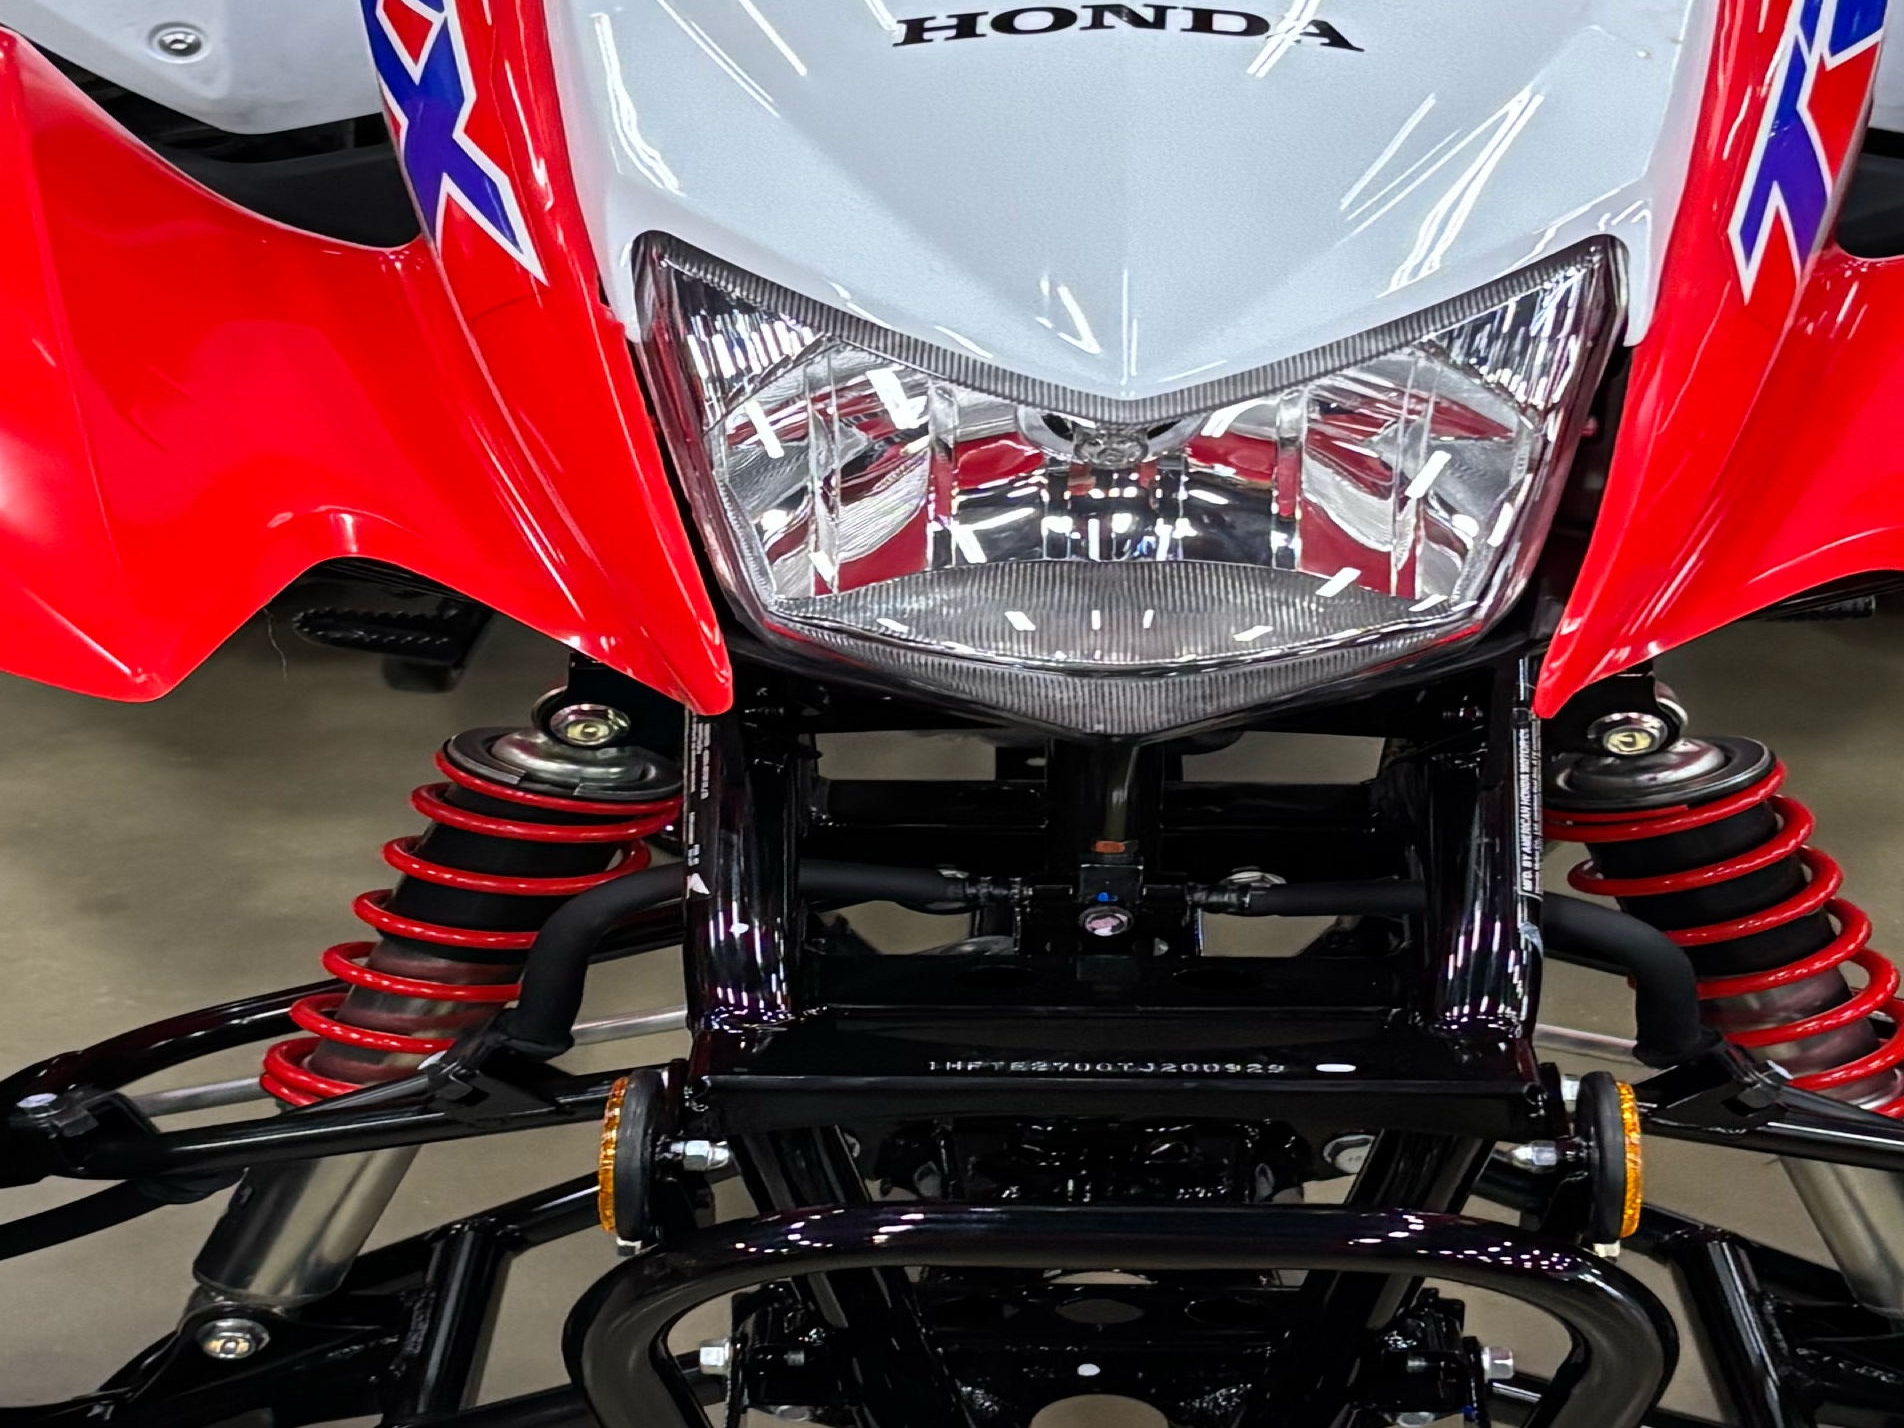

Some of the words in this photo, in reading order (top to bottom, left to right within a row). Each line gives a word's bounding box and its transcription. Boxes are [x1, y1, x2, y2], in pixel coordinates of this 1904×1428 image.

[892, 4, 1366, 54] HONDA
[1519, 773, 1531, 805] HONDA
[1519, 806, 1532, 853] AMERICAN
[1521, 854, 1532, 867] BY
[1521, 870, 1532, 891] MFD.
